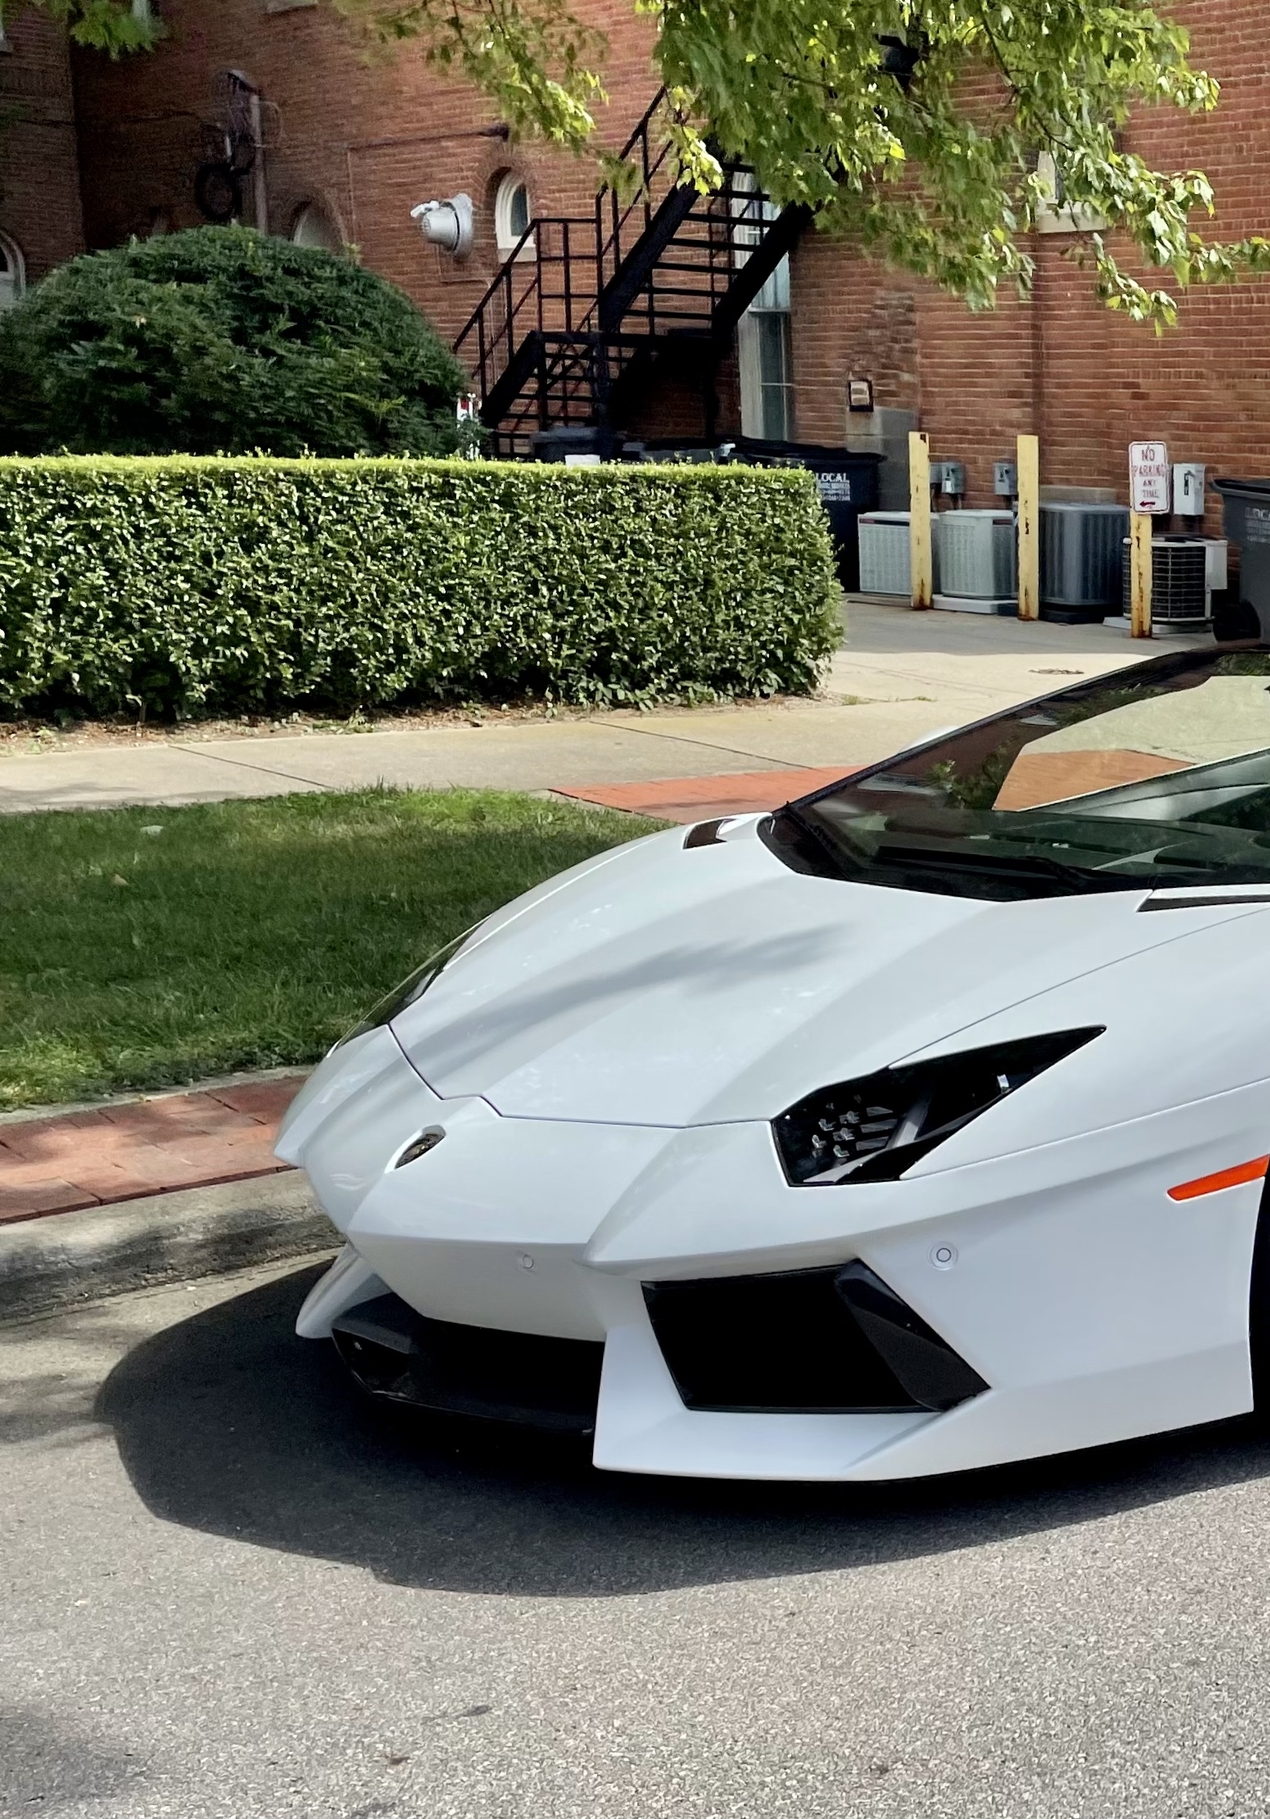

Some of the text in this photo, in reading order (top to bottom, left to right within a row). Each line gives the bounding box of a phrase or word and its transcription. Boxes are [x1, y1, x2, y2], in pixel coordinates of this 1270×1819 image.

[1141, 448, 1156, 462] NO
[1131, 464, 1166, 477] PARKING
[815, 472, 849, 483] LOCAL
[1141, 489, 1160, 498] TIME
